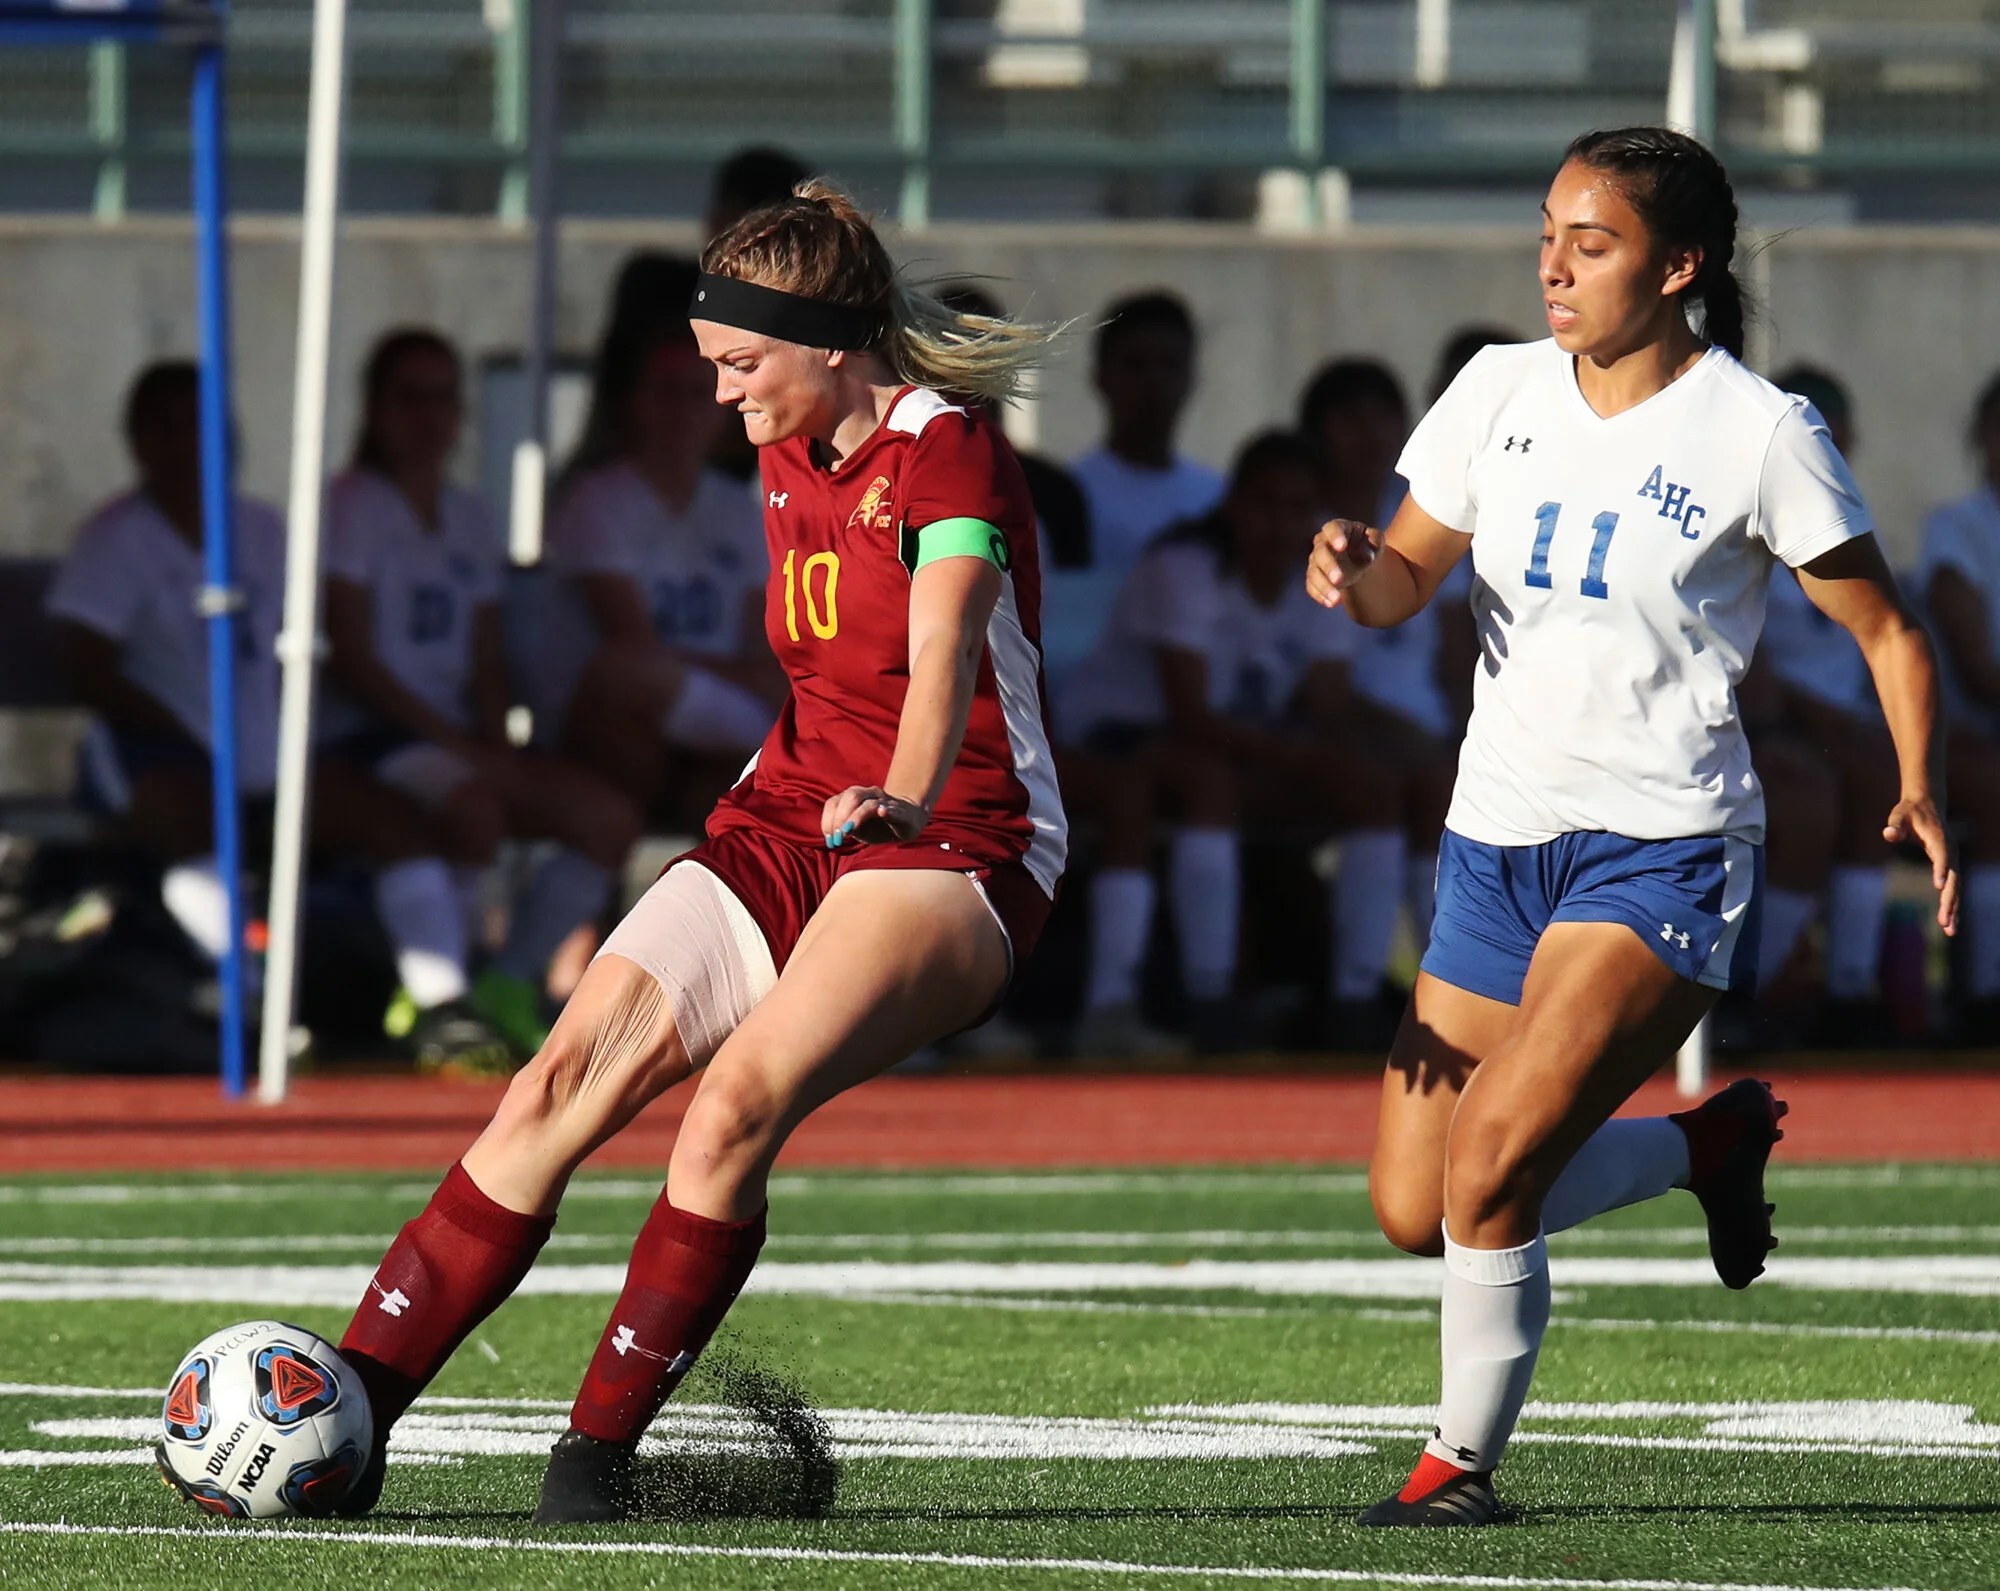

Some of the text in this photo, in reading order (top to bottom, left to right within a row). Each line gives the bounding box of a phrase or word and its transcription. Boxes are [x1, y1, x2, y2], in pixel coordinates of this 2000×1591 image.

[1637, 464, 1706, 540] AHC
[1524, 501, 1620, 600] 11
[783, 549, 840, 642] 10
[205, 1421, 250, 1476] Wilson
[238, 1443, 276, 1493] NCAA
